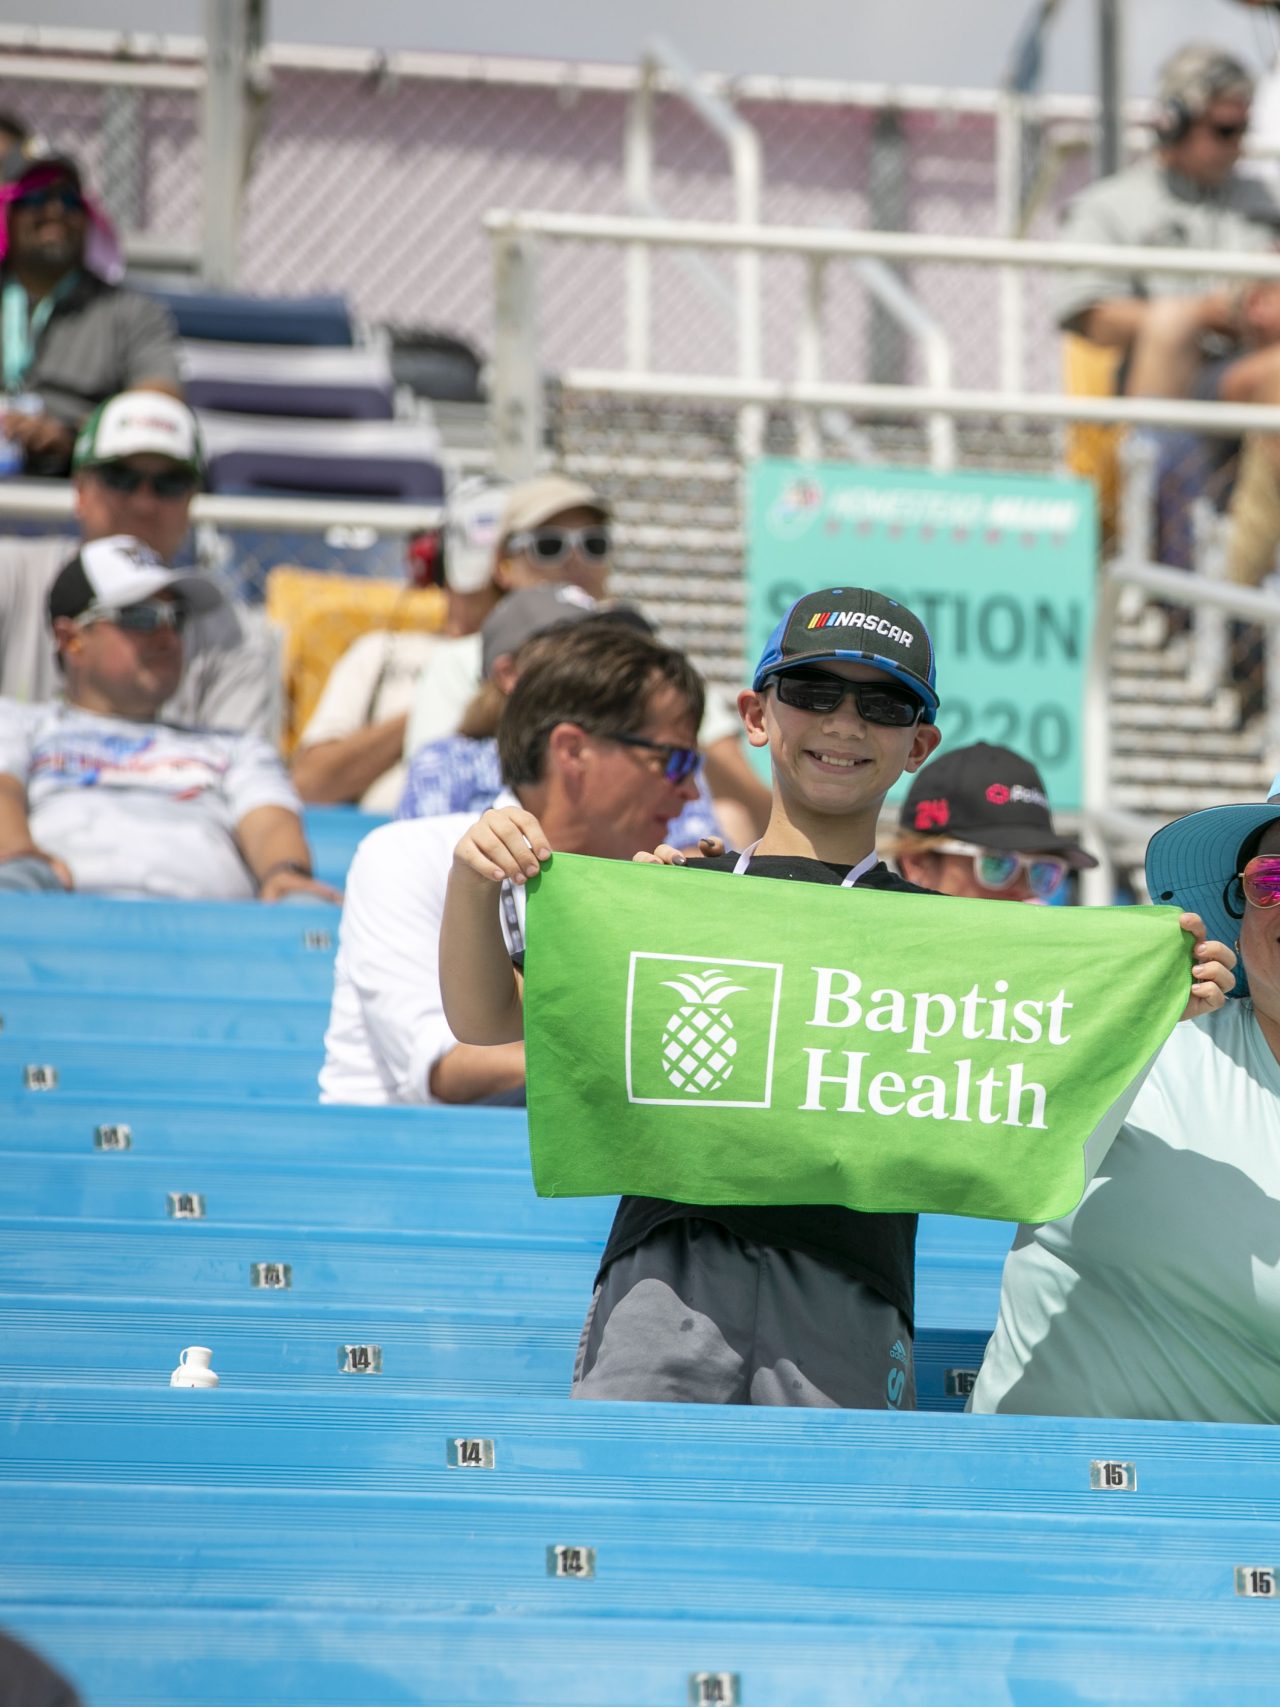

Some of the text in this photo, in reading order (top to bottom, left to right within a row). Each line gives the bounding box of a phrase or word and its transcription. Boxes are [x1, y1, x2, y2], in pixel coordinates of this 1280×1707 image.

[766, 581, 1083, 666] STION
[834, 611, 914, 648] NASCAR
[805, 966, 1073, 1053] Baptist
[798, 1047, 1048, 1129] Health
[348, 1347, 371, 1369] 14
[459, 1441, 482, 1464] 14
[1104, 1463, 1123, 1485] 15
[560, 1549, 582, 1573] 14
[1250, 1571, 1271, 1594] 15
